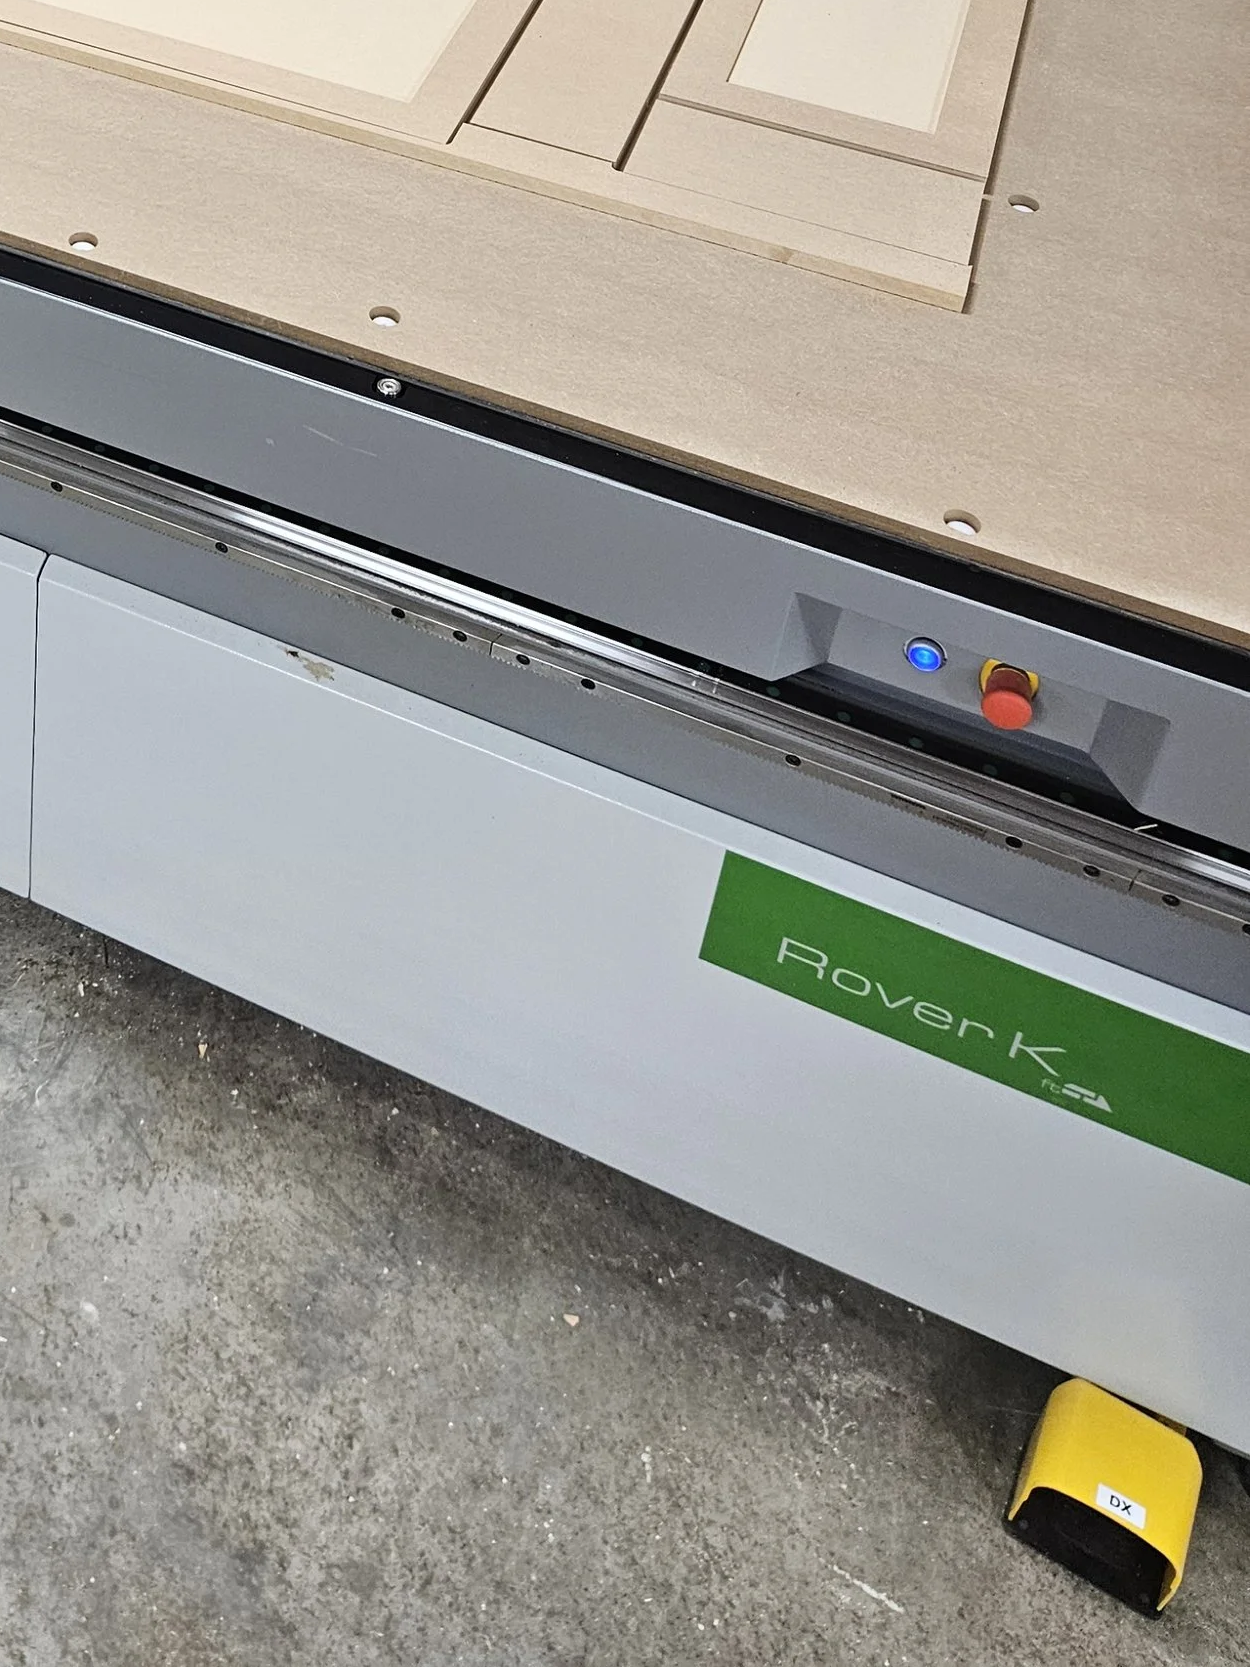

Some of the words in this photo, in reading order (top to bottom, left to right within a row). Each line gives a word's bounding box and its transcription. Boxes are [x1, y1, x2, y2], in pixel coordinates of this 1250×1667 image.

[777, 936, 995, 1039] Rover
[1008, 1031, 1067, 1077] K
[1109, 1494, 1133, 1516] DX
